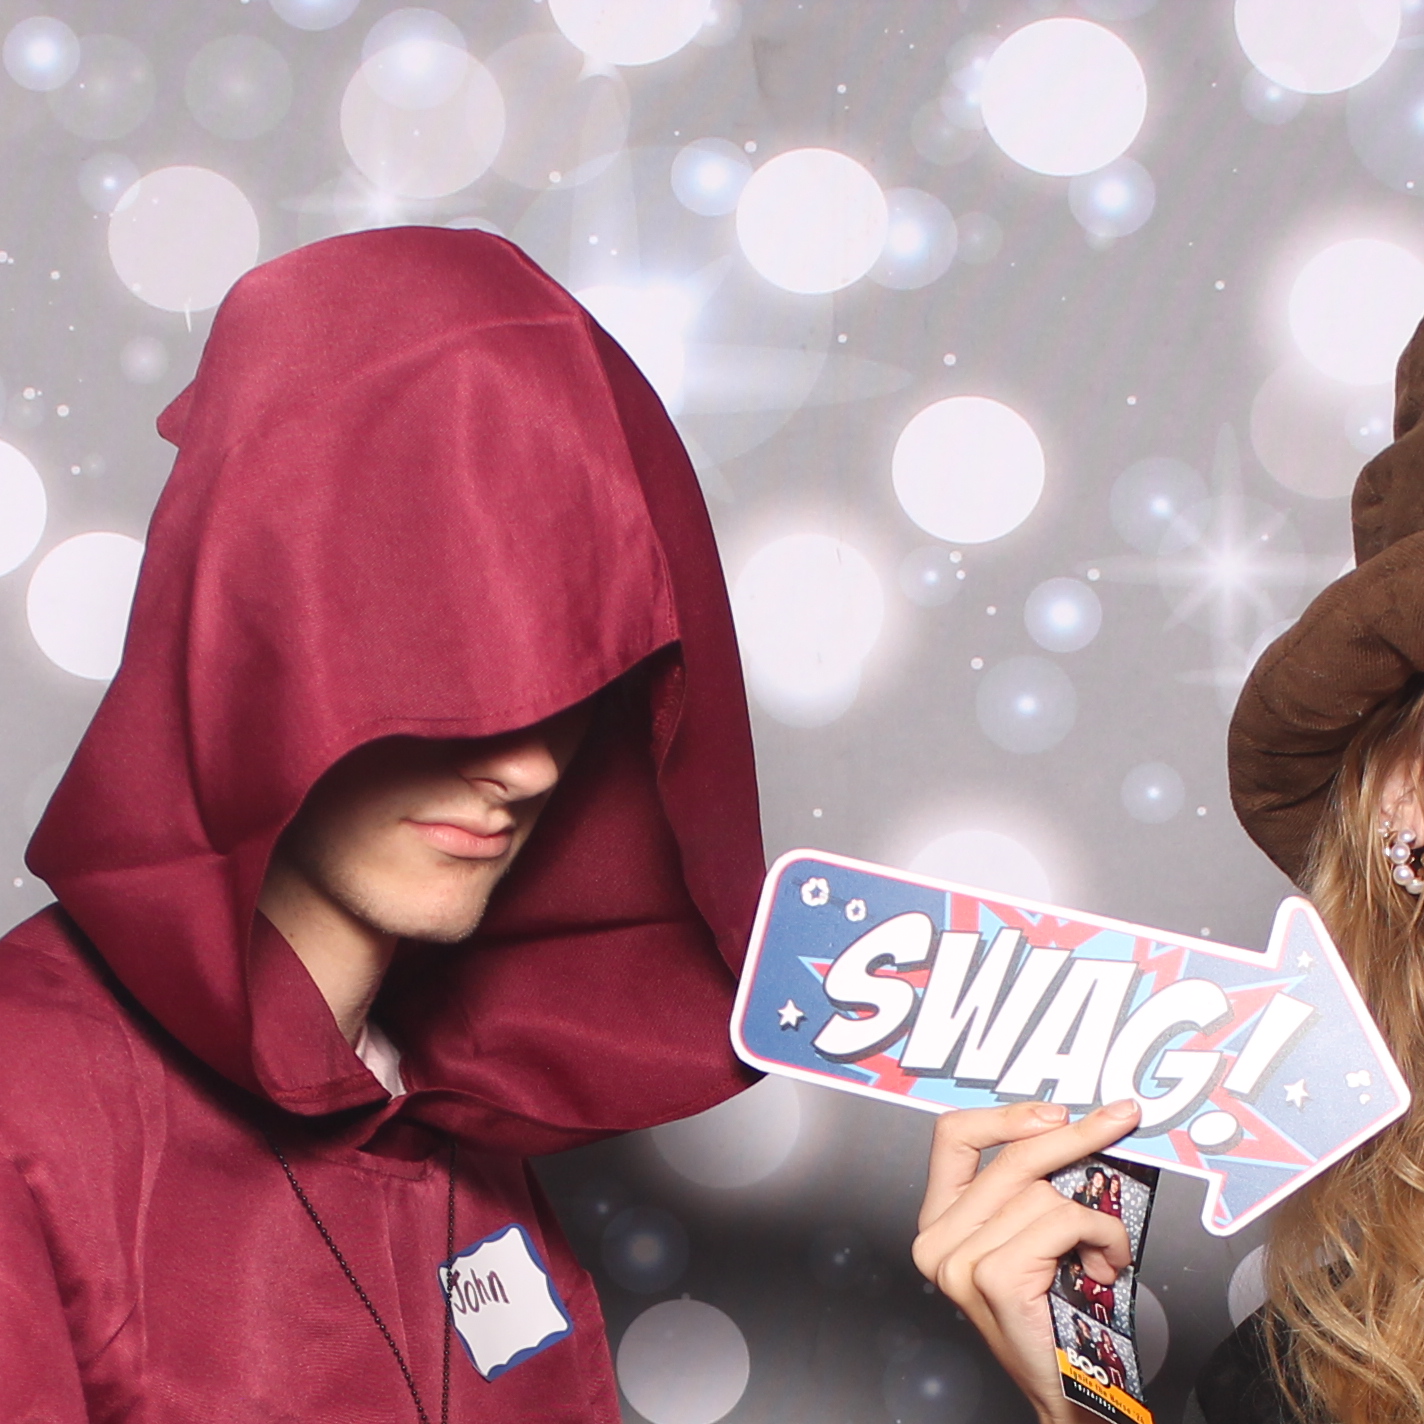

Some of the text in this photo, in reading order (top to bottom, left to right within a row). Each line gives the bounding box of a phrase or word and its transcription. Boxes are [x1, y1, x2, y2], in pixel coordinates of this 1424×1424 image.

[812, 911, 1321, 1153] SWAG!
[450, 1268, 510, 1314] John
[1066, 1346, 1109, 1386] BOO
